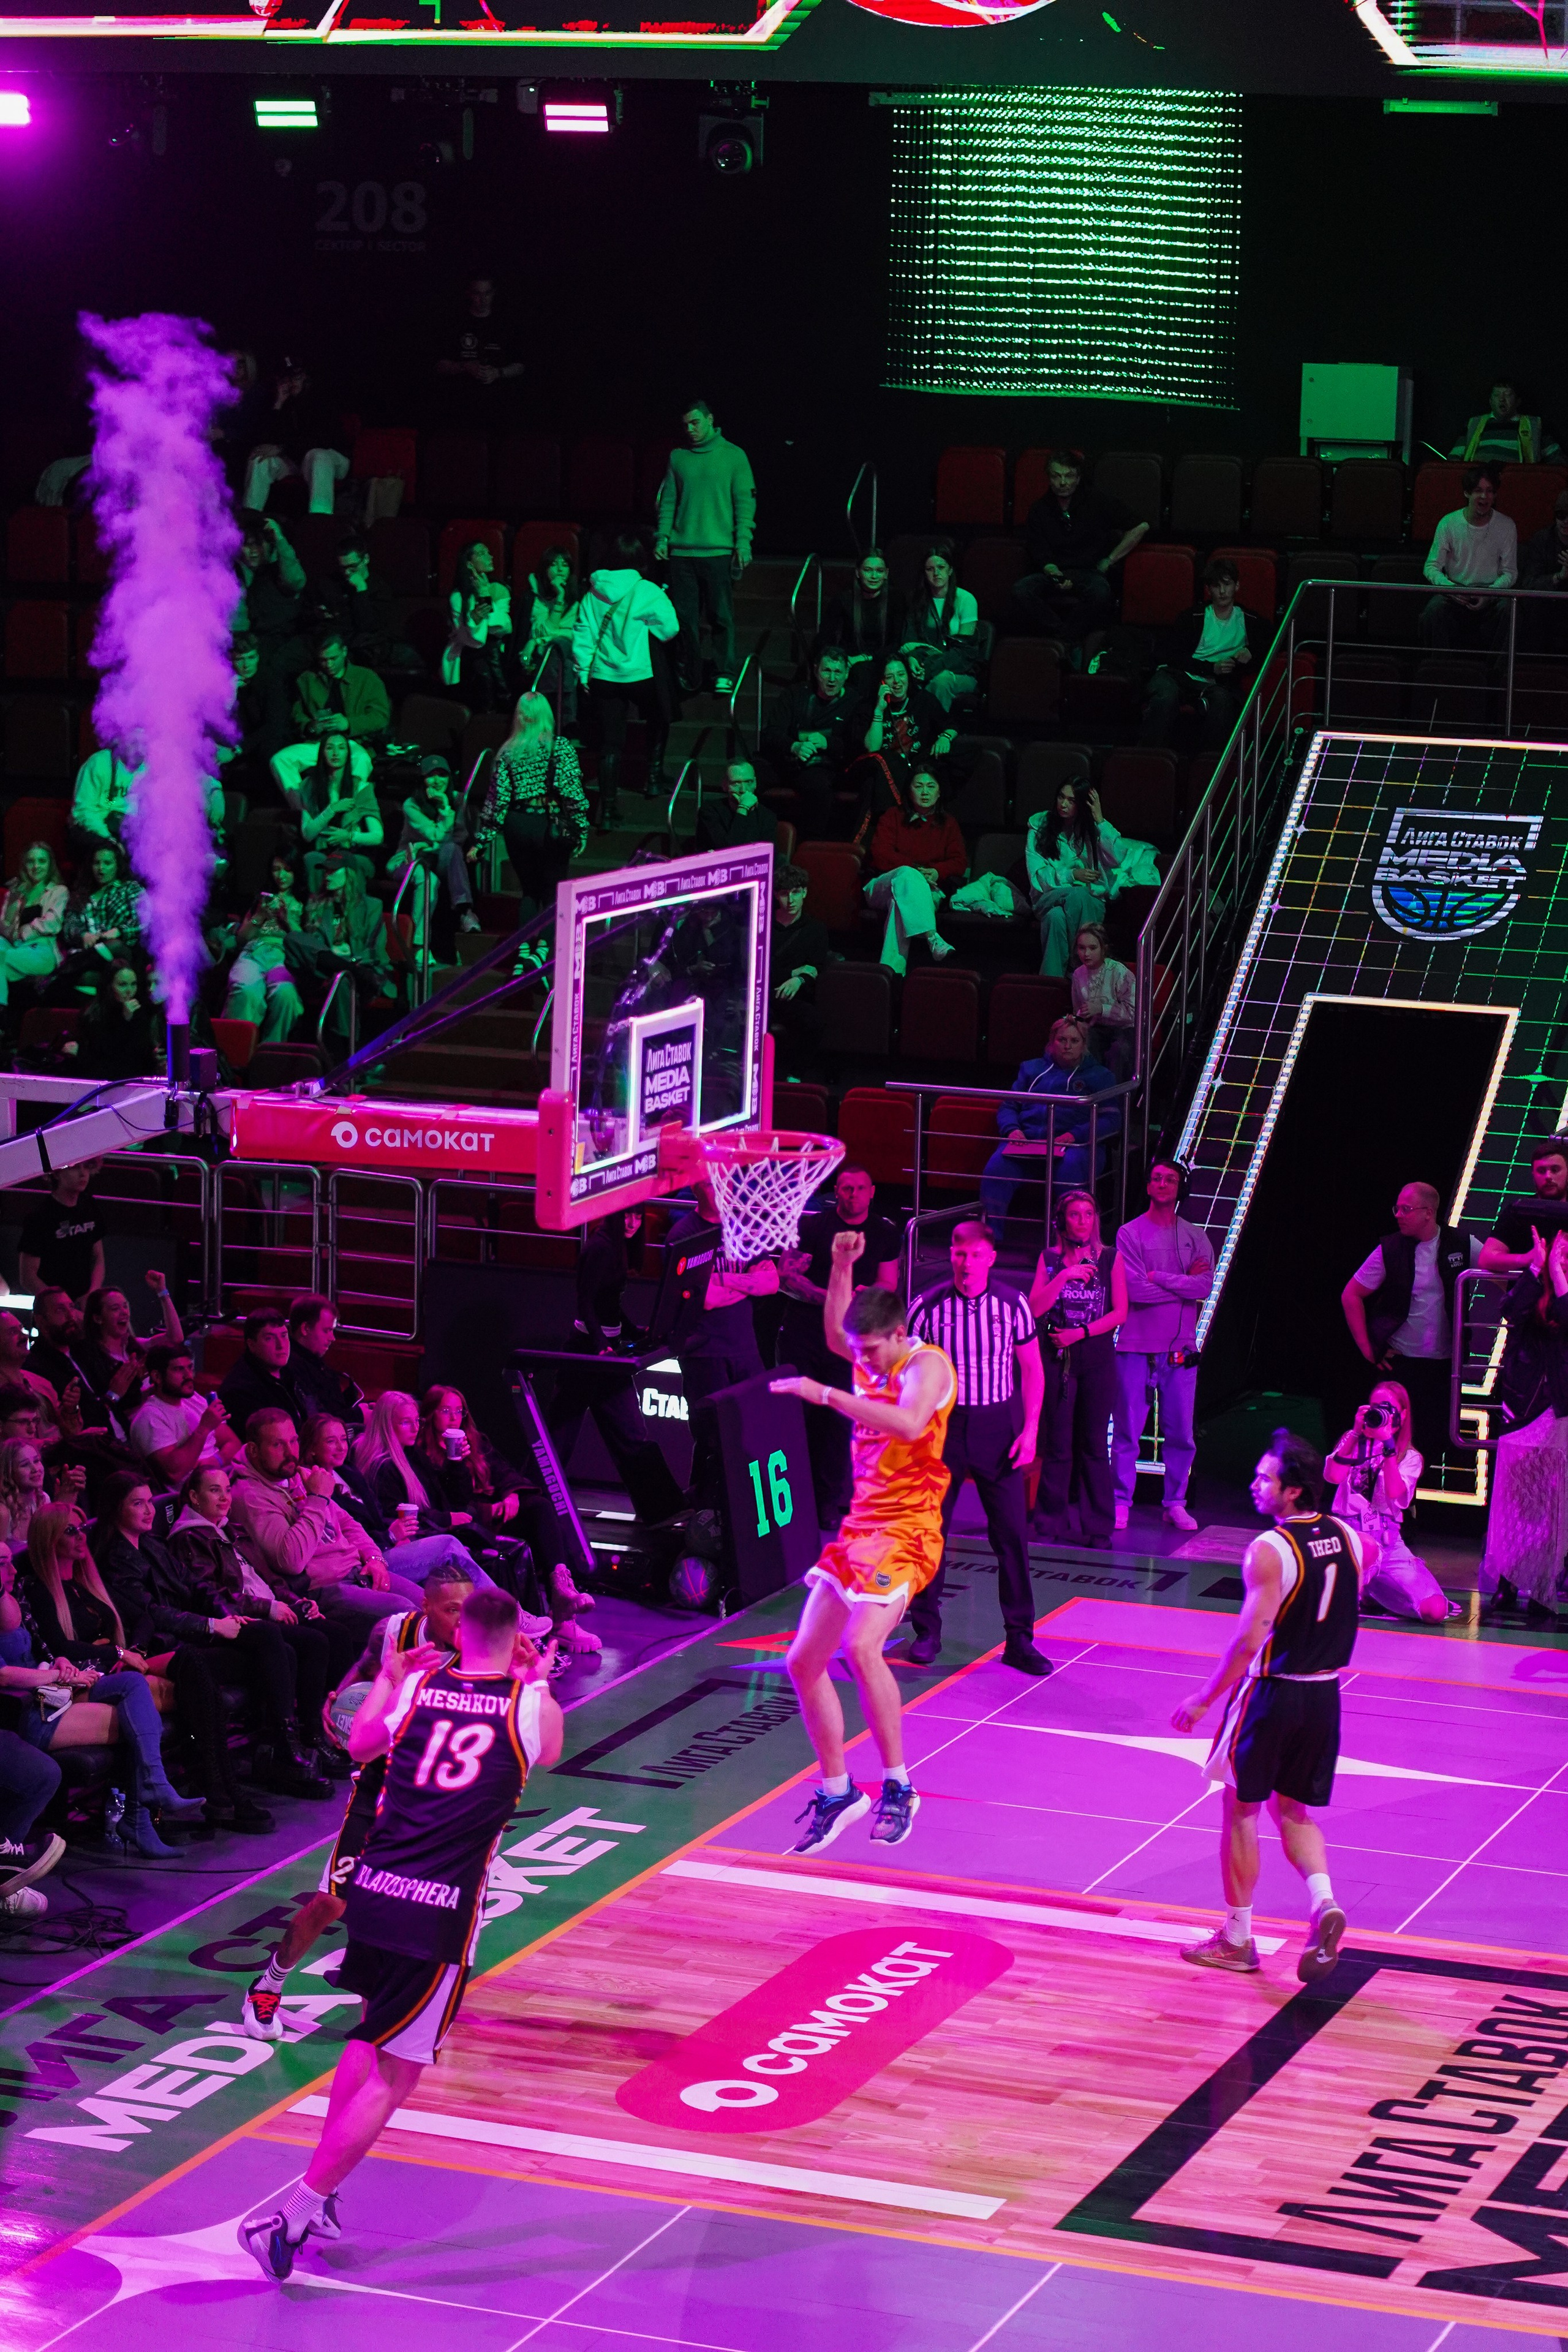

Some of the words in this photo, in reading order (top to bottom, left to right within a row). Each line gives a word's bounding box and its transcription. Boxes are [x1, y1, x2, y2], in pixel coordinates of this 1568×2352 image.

[315, 181, 428, 233] 208
[1374, 867, 1527, 889] BASKET
[1378, 846, 1528, 874] MEDIA
[644, 1065, 690, 1096] MEDIA
[644, 1085, 691, 1114] BASKET
[532, 1439, 568, 1516] YAMAGUCHI
[748, 1449, 794, 1538] 16
[1307, 1536, 1343, 1558] THEO
[1028, 1569, 1145, 1591] ТАВОК
[1317, 1562, 1338, 1623] 1
[415, 1687, 512, 1717] MESHKOV
[415, 1719, 496, 1789] 13
[353, 1863, 462, 1910] BLATOSPHERA
[0, 1994, 230, 2129] ИГА
